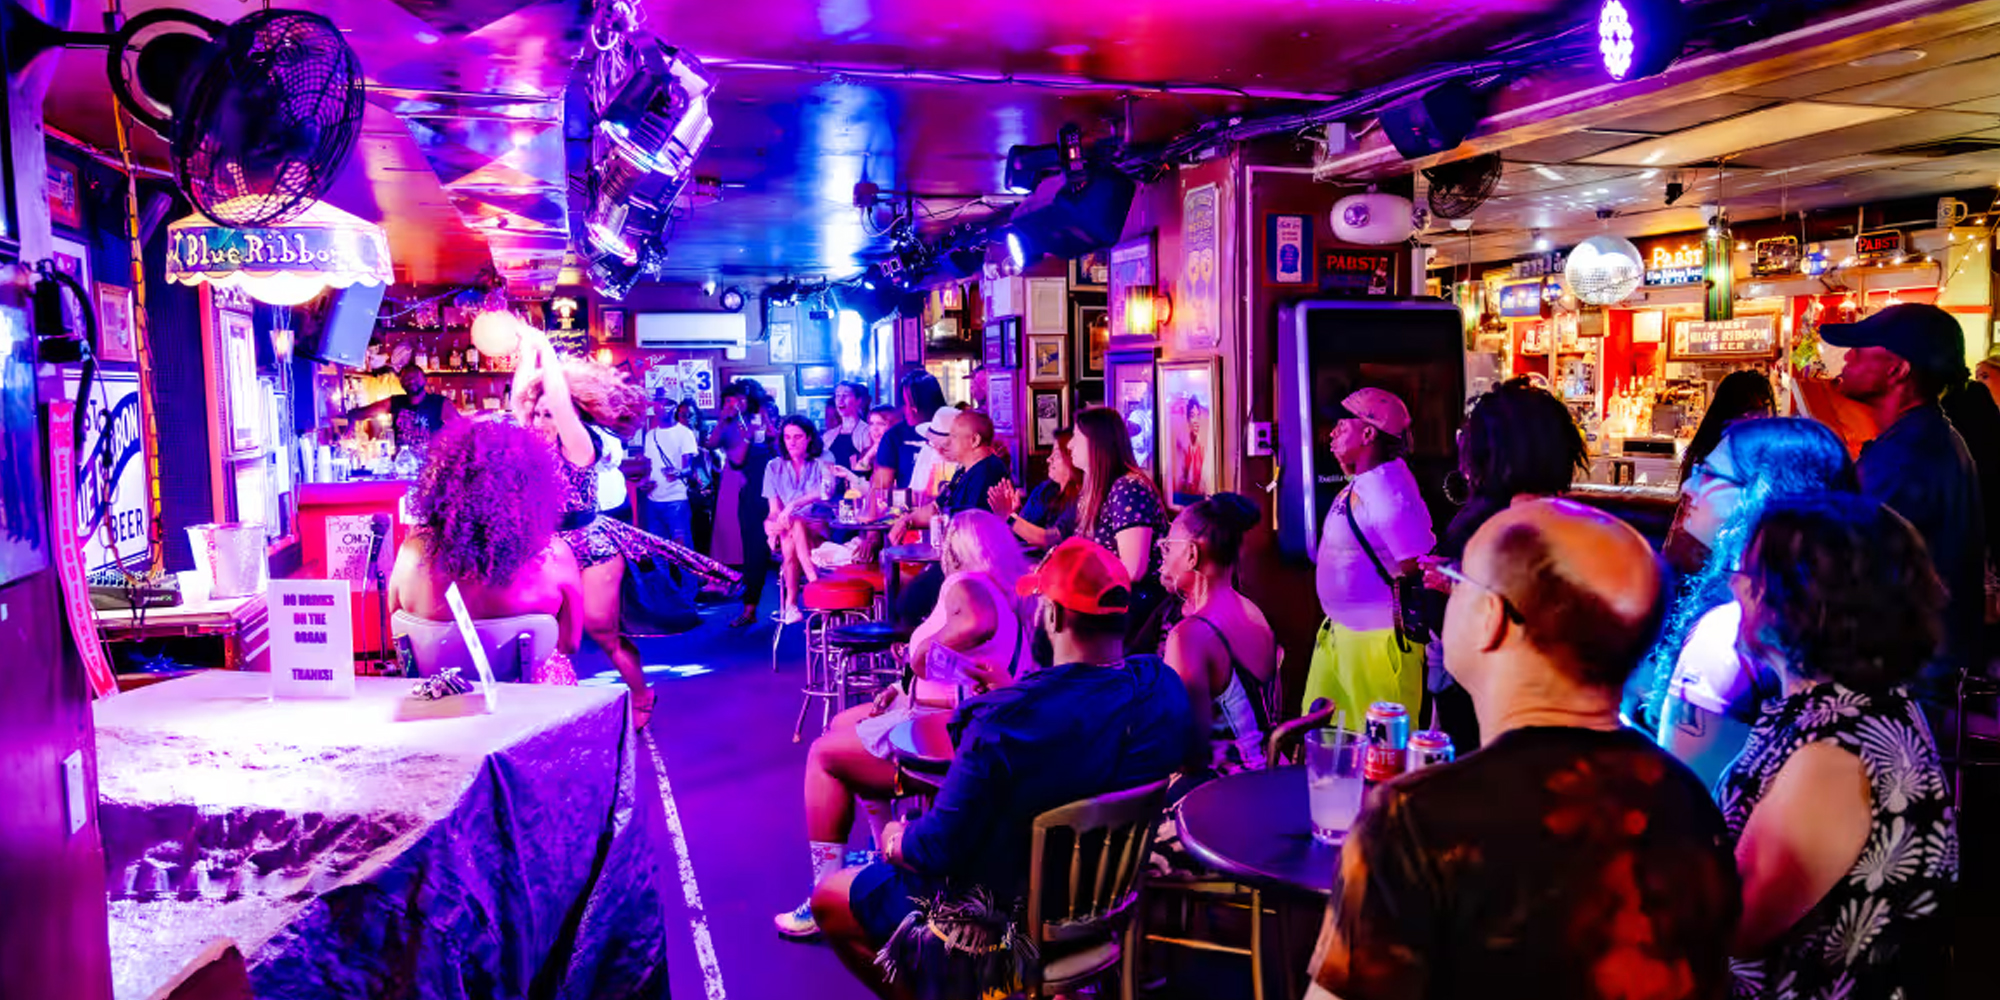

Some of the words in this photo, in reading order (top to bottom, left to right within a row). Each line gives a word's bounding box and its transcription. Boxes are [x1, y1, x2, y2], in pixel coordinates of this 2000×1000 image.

[187, 234, 240, 266] Blue
[1858, 236, 1900, 251] PABST
[1326, 255, 1377, 271] PABST
[1708, 320, 1748, 331] PABST
[1710, 342, 1745, 350] BEER
[697, 371, 711, 390] 3
[110, 508, 145, 544] BEER
[342, 533, 371, 546] ONLY
[283, 594, 297, 606] NO
[299, 594, 335, 606] DRINKS
[293, 613, 307, 625] ON
[308, 613, 327, 625] THE
[294, 631, 327, 644] ORGAN
[292, 668, 333, 681] THANKS!
